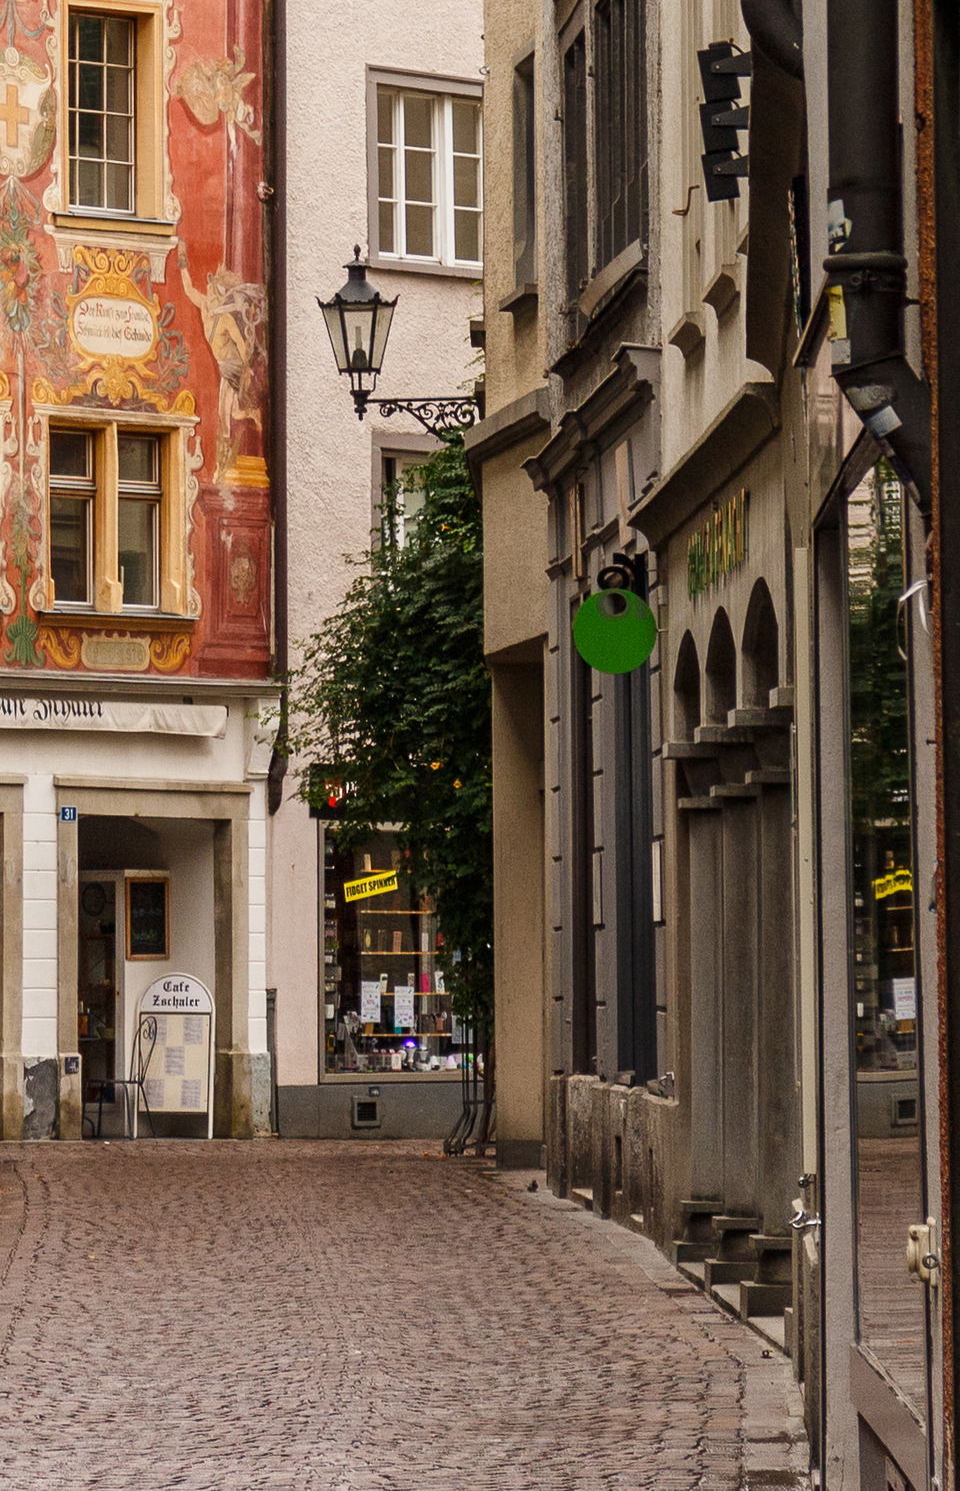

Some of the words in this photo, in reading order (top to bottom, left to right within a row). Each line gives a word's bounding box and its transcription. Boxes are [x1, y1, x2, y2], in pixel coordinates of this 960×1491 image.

[64, 808, 74, 820] 31
[346, 882, 368, 898] FIDGET
[163, 981, 190, 993] Cafe
[152, 994, 201, 1009] Zschaler
